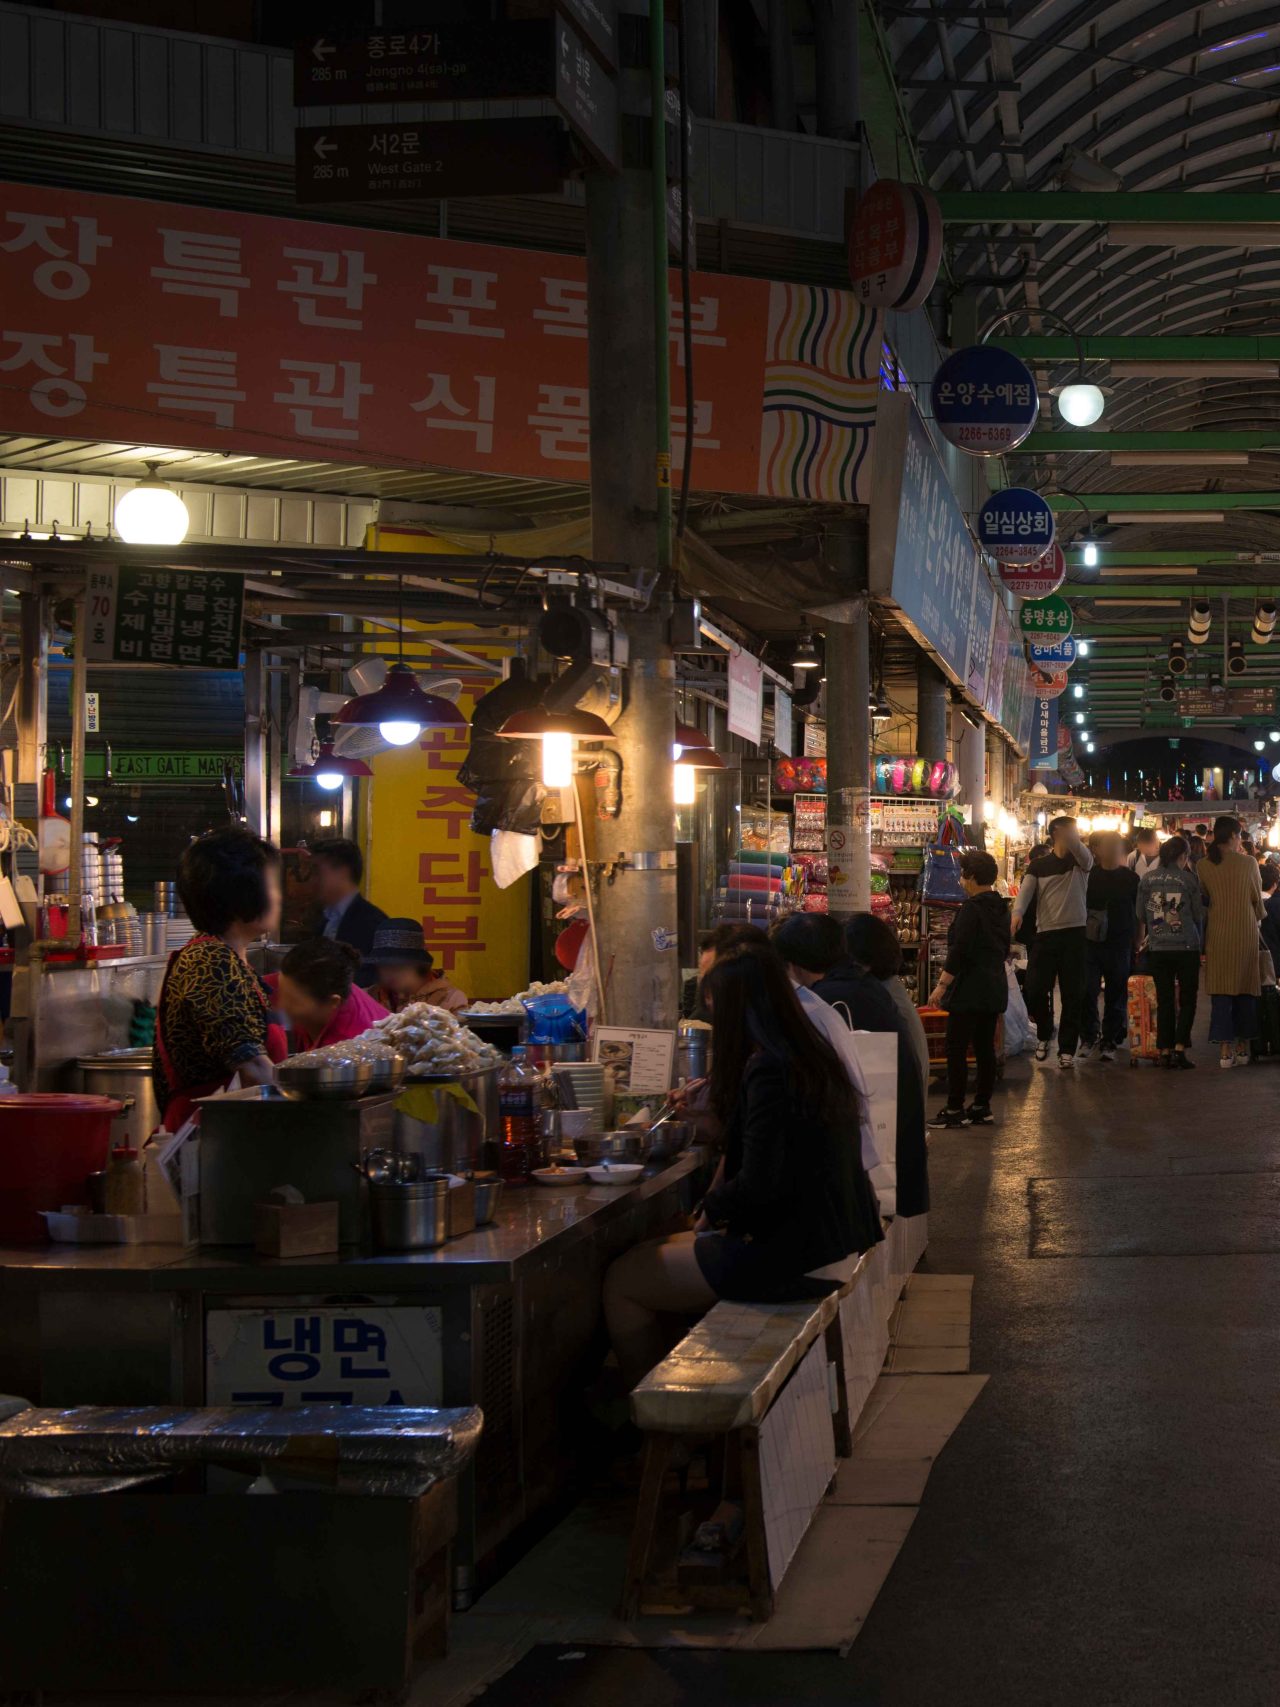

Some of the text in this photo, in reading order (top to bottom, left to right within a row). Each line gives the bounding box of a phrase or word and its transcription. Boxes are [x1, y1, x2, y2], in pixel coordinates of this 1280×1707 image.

[366, 32, 441, 60] 종로4가
[311, 68, 348, 81] 285 m
[365, 63, 413, 80] Jongno
[368, 133, 421, 156] 서2문
[312, 165, 349, 180] 285 m
[367, 160, 444, 176] West Gate 2
[861, 273, 887, 299] 입구
[936, 381, 1031, 407] 온양수예점
[983, 511, 1049, 536] 일심상회
[91, 596, 111, 617] 70
[1021, 607, 1070, 627] 동명홍삼
[93, 623, 106, 645] 호
[119, 589, 150, 658] 수제비
[117, 757, 150, 775] EAST
[156, 757, 193, 775] GATE
[262, 1315, 391, 1382] 냉면
